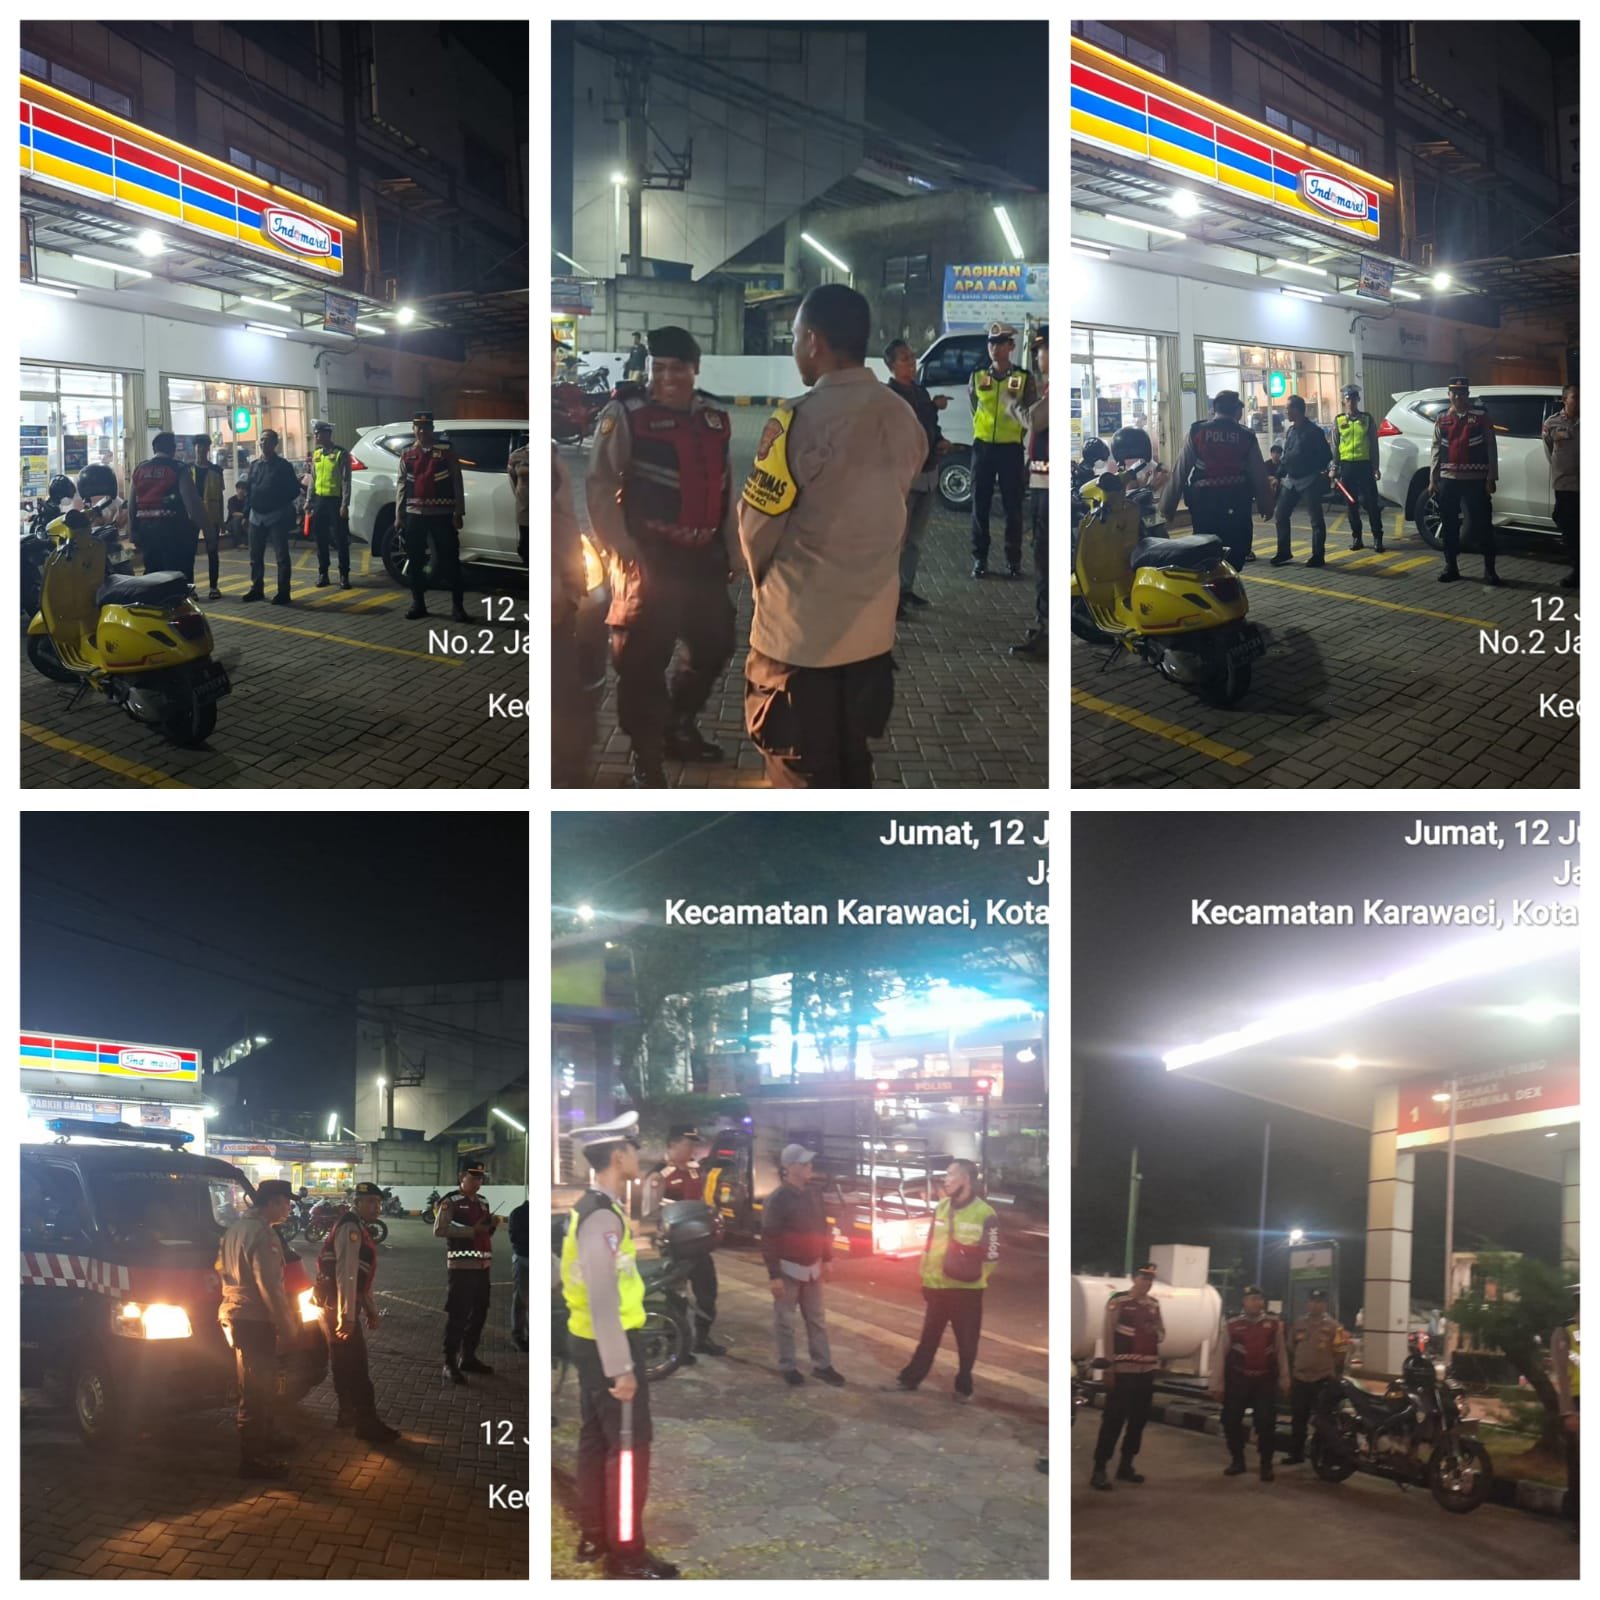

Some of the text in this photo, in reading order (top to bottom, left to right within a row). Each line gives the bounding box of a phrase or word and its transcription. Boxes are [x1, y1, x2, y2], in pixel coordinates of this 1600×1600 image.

[1309, 179, 1364, 213] Indomaret
[272, 217, 327, 250] Indomaret
[952, 265, 1021, 278] TAGIHAN
[954, 280, 1018, 291] APA AJA
[1205, 431, 1240, 443] POLISI
[1409, 1106, 1420, 1123] 1
